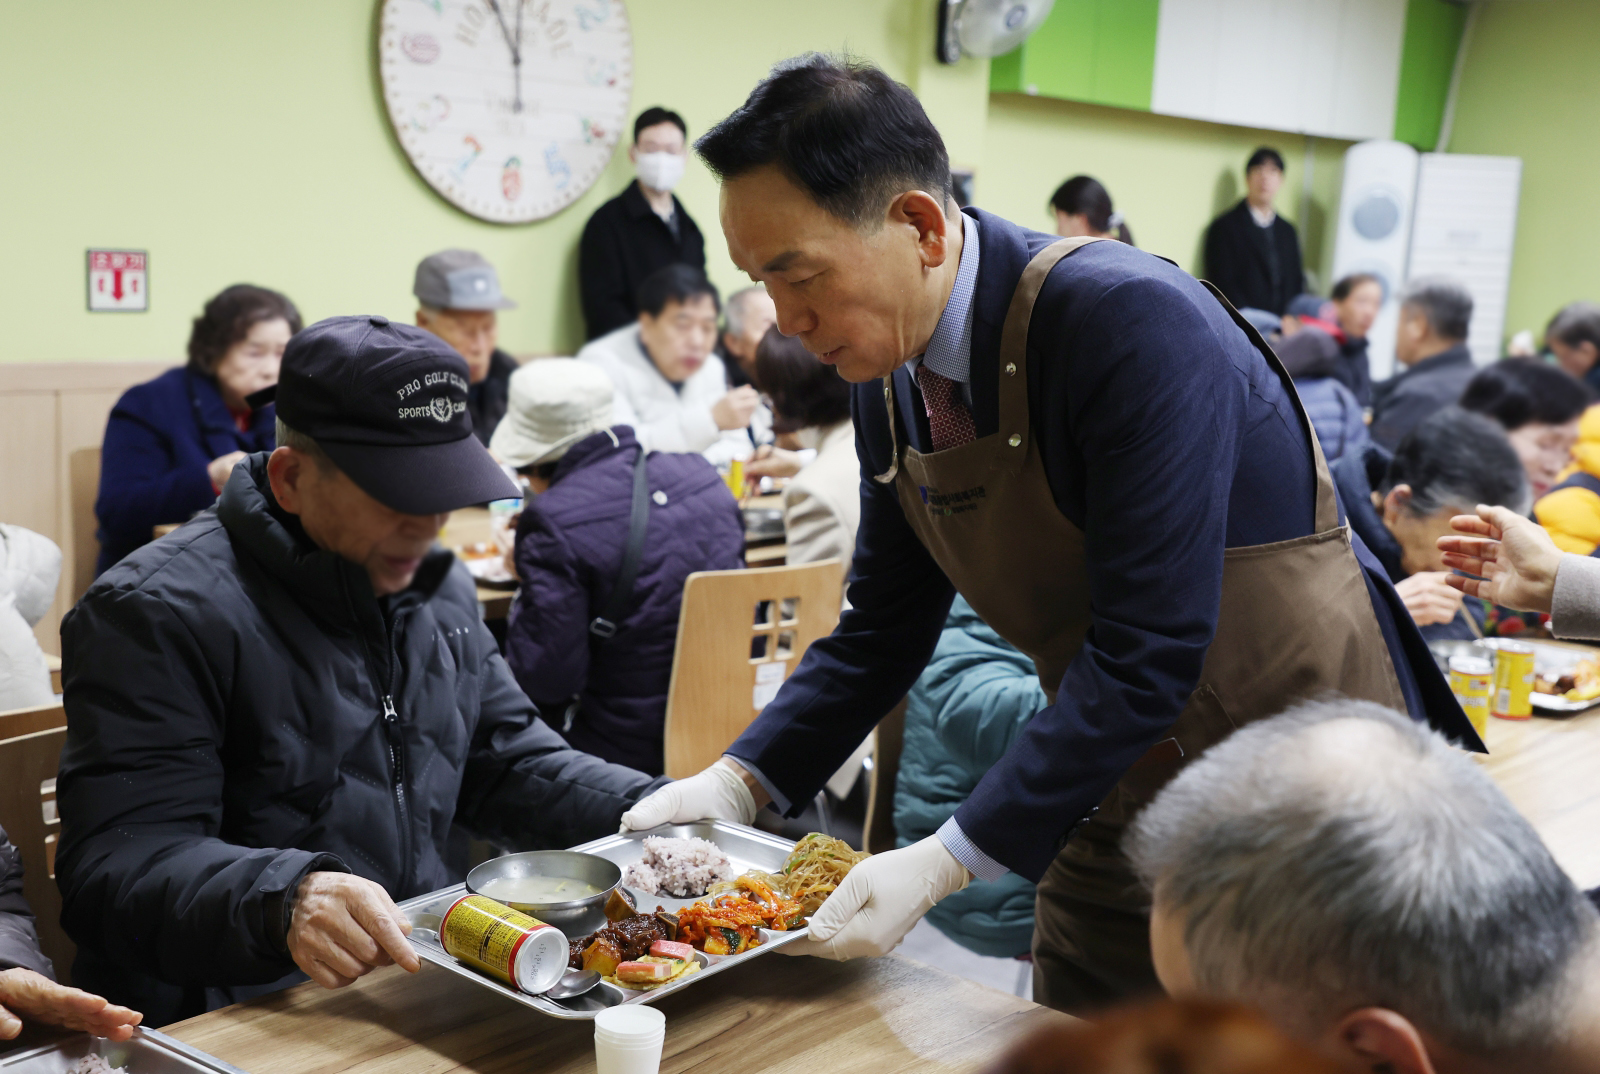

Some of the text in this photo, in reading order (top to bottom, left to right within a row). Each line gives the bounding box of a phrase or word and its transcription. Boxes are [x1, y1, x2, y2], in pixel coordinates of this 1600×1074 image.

[92, 252, 145, 270] 소화기
[397, 379, 421, 400] PRO
[425, 372, 449, 386] GOLF
[398, 405, 431, 418] SPORTS
